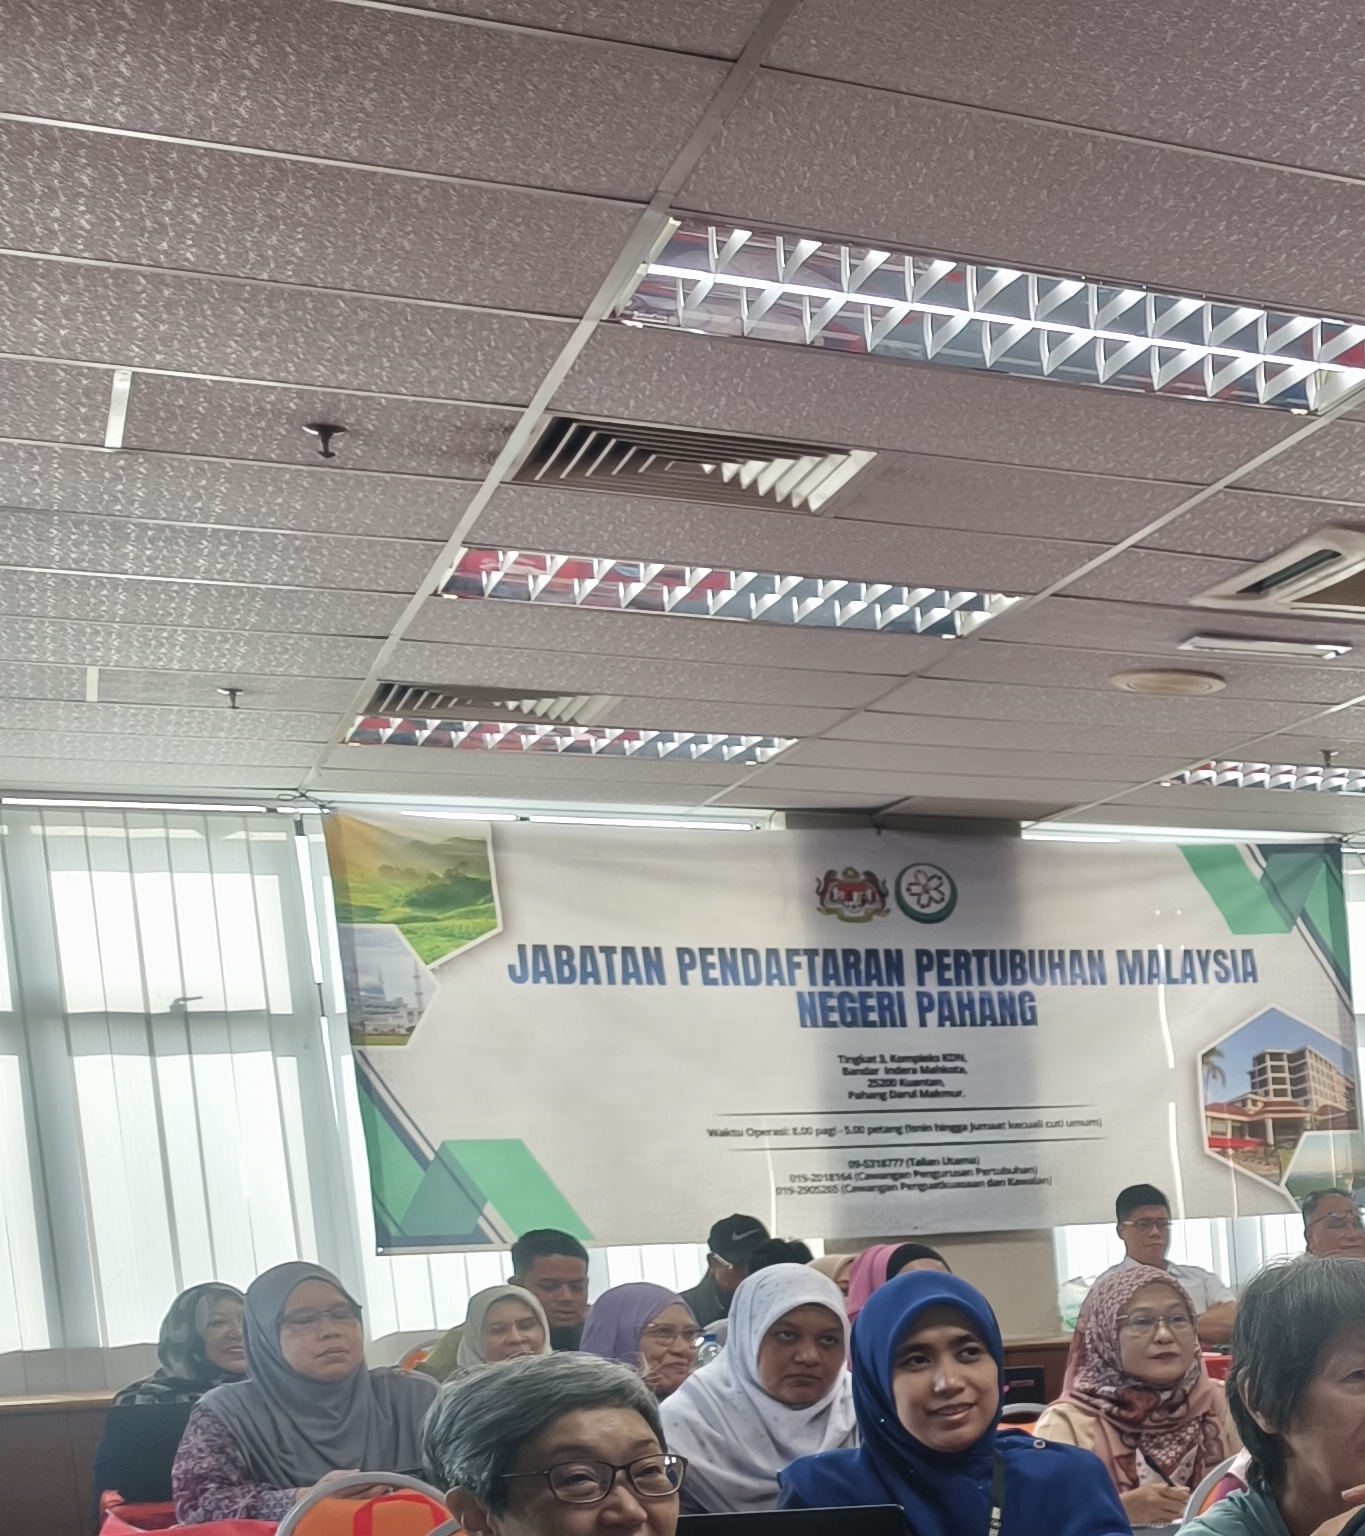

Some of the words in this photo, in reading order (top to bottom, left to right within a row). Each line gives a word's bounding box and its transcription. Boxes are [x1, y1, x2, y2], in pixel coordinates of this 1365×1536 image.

[508, 943, 667, 986] JABATAN
[675, 946, 905, 987] PENDAFTARAN
[914, 948, 1108, 987] PERTUBUHAN
[1115, 948, 1259, 985] MALAYSIA
[796, 990, 908, 1029] NEGERI
[917, 989, 1039, 1028] PAHANG
[837, 1053, 877, 1066] Tingkat
[889, 1053, 940, 1065] Kompleks
[842, 1066, 880, 1076] Bandar
[884, 1066, 918, 1075] Indera
[847, 1089, 889, 1101] Pahang
[888, 1089, 918, 1099] Darul
[707, 1127, 744, 1137] Waktu
[815, 1126, 837, 1138] pagi
[867, 1125, 904, 1137] petang
[987, 1177, 1006, 1188] dan
